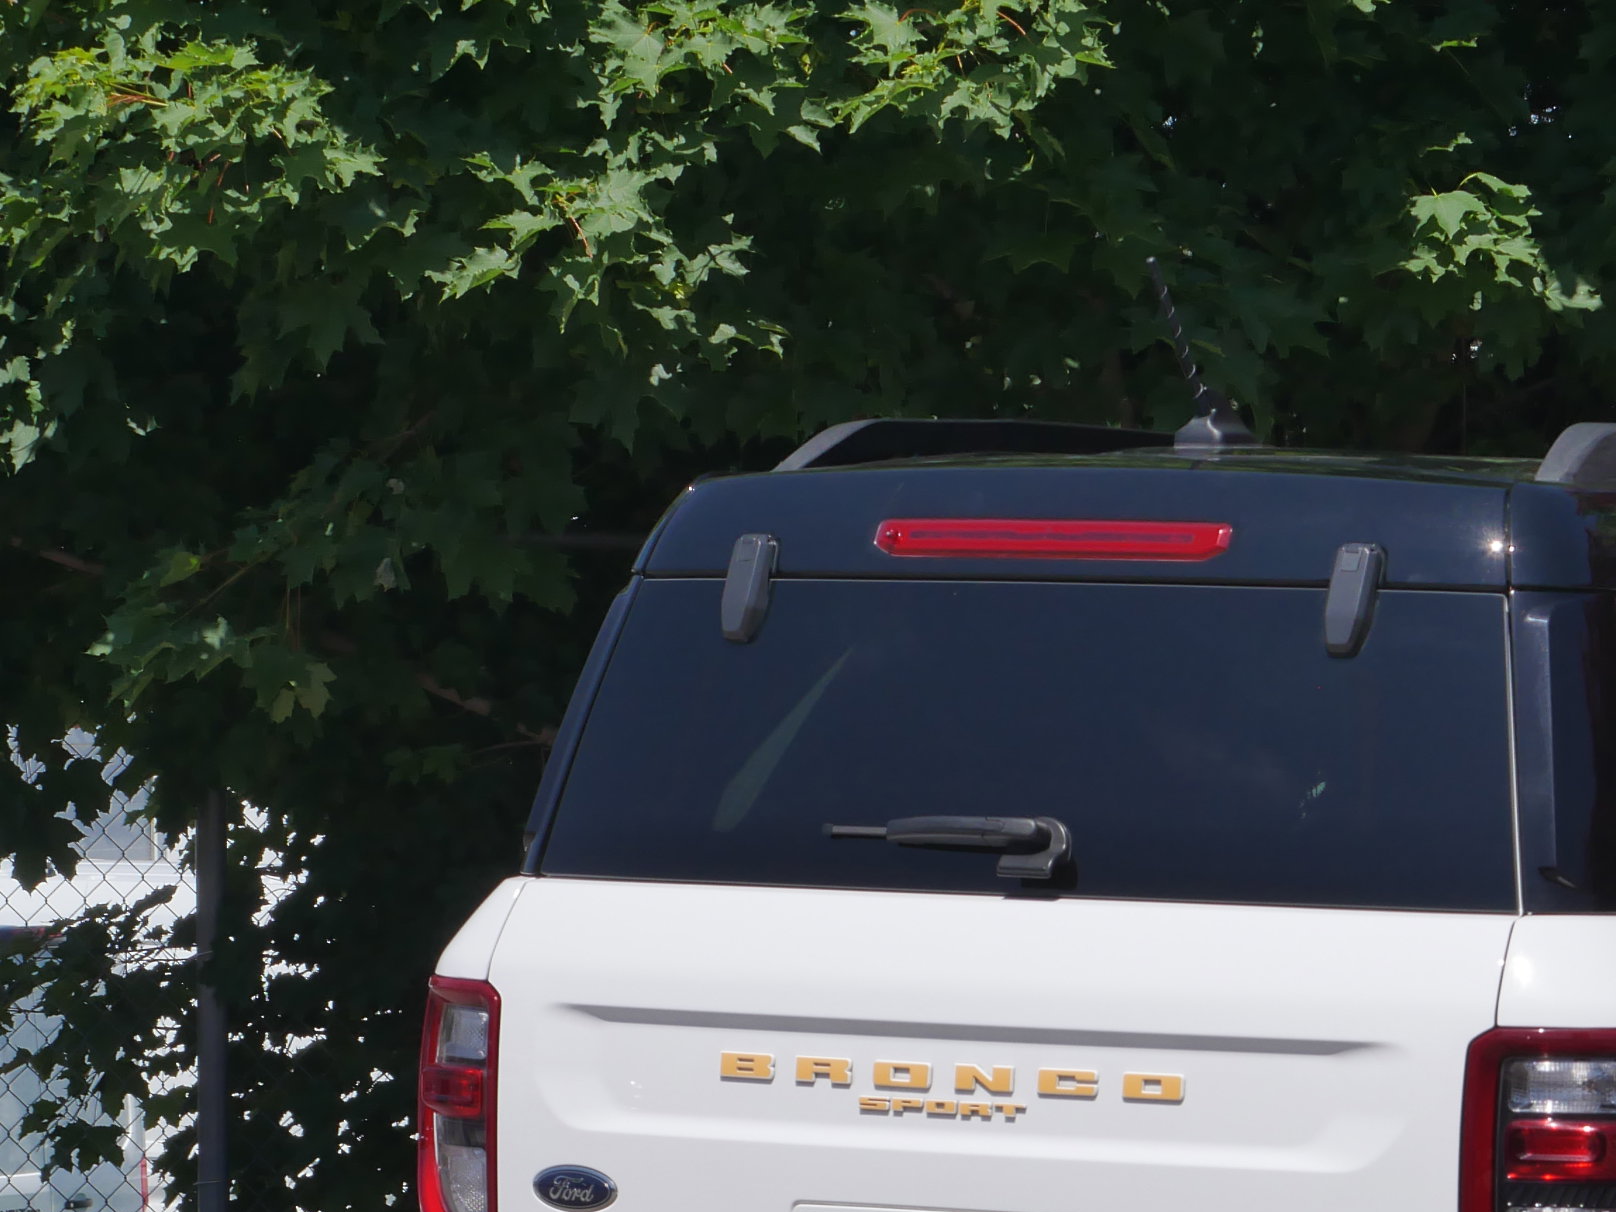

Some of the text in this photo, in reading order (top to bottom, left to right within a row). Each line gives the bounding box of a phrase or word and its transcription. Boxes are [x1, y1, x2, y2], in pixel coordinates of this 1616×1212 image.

[720, 1050, 1187, 1103] BRONCO
[858, 1095, 1027, 1122] SPORT
[549, 1175, 595, 1202] Ford
